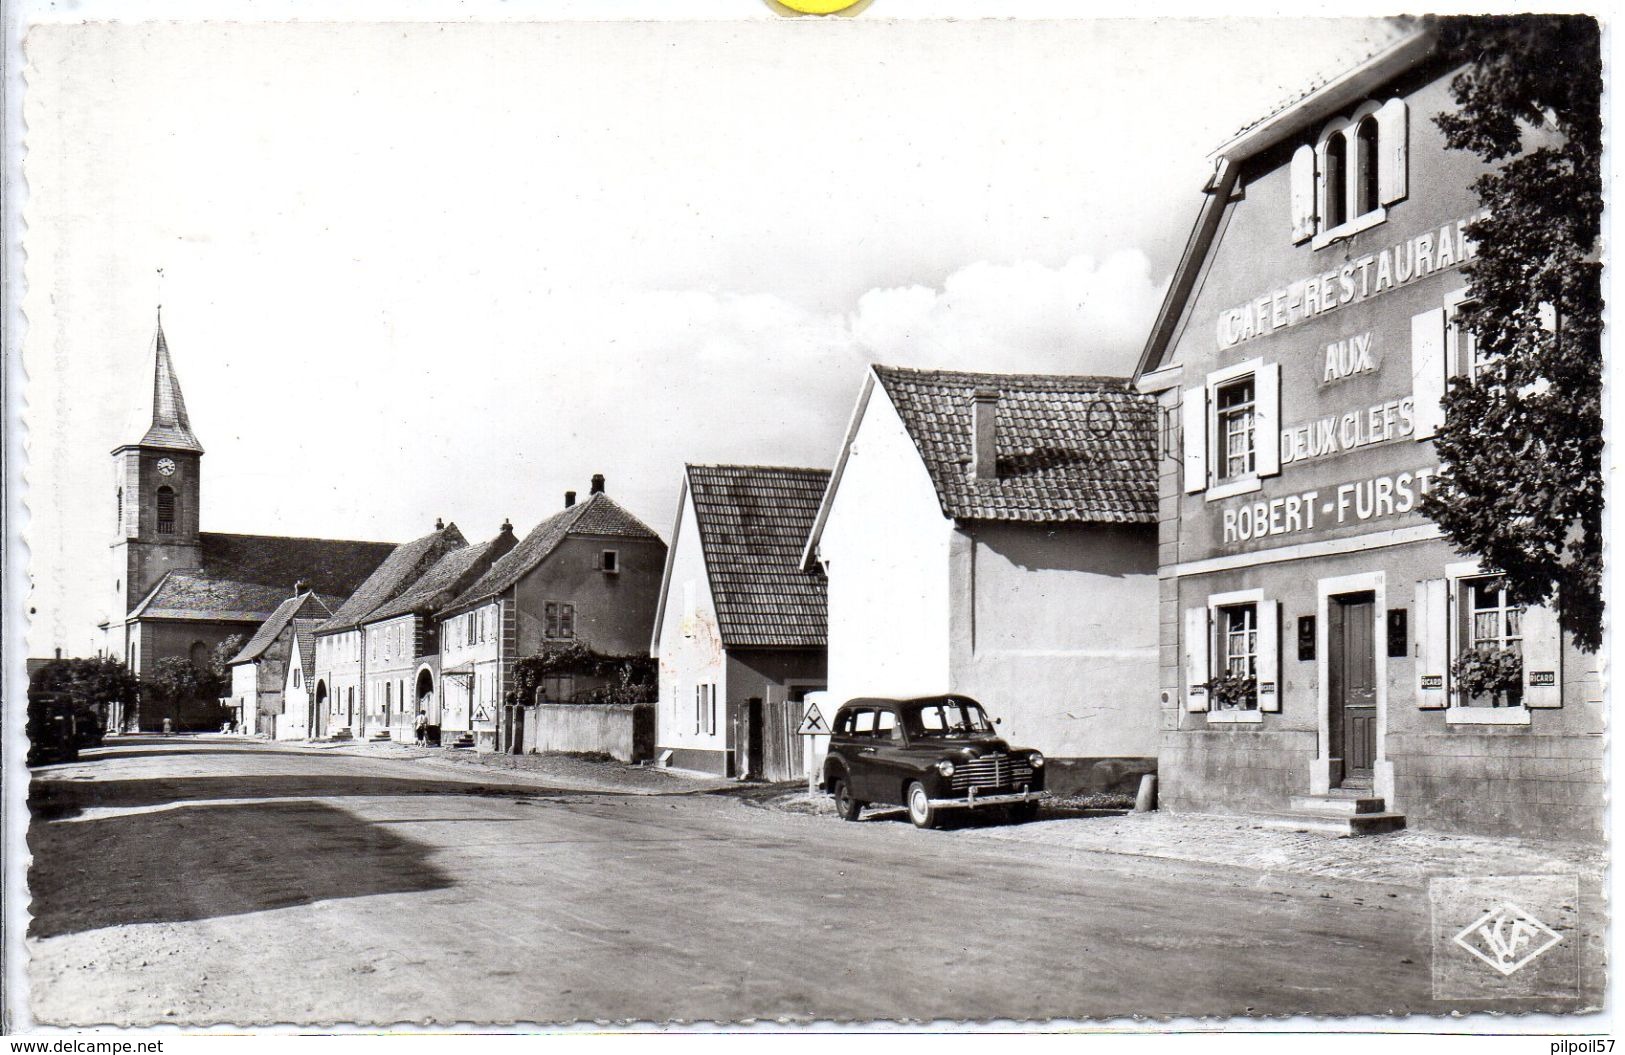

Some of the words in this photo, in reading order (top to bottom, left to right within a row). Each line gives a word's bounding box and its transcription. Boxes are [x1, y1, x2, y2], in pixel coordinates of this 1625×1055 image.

[1324, 332, 1374, 382] AUX
[1281, 415, 1338, 464] DEUX
[1340, 398, 1415, 450] CLEFS
[1530, 674, 1554, 682] RICARD
